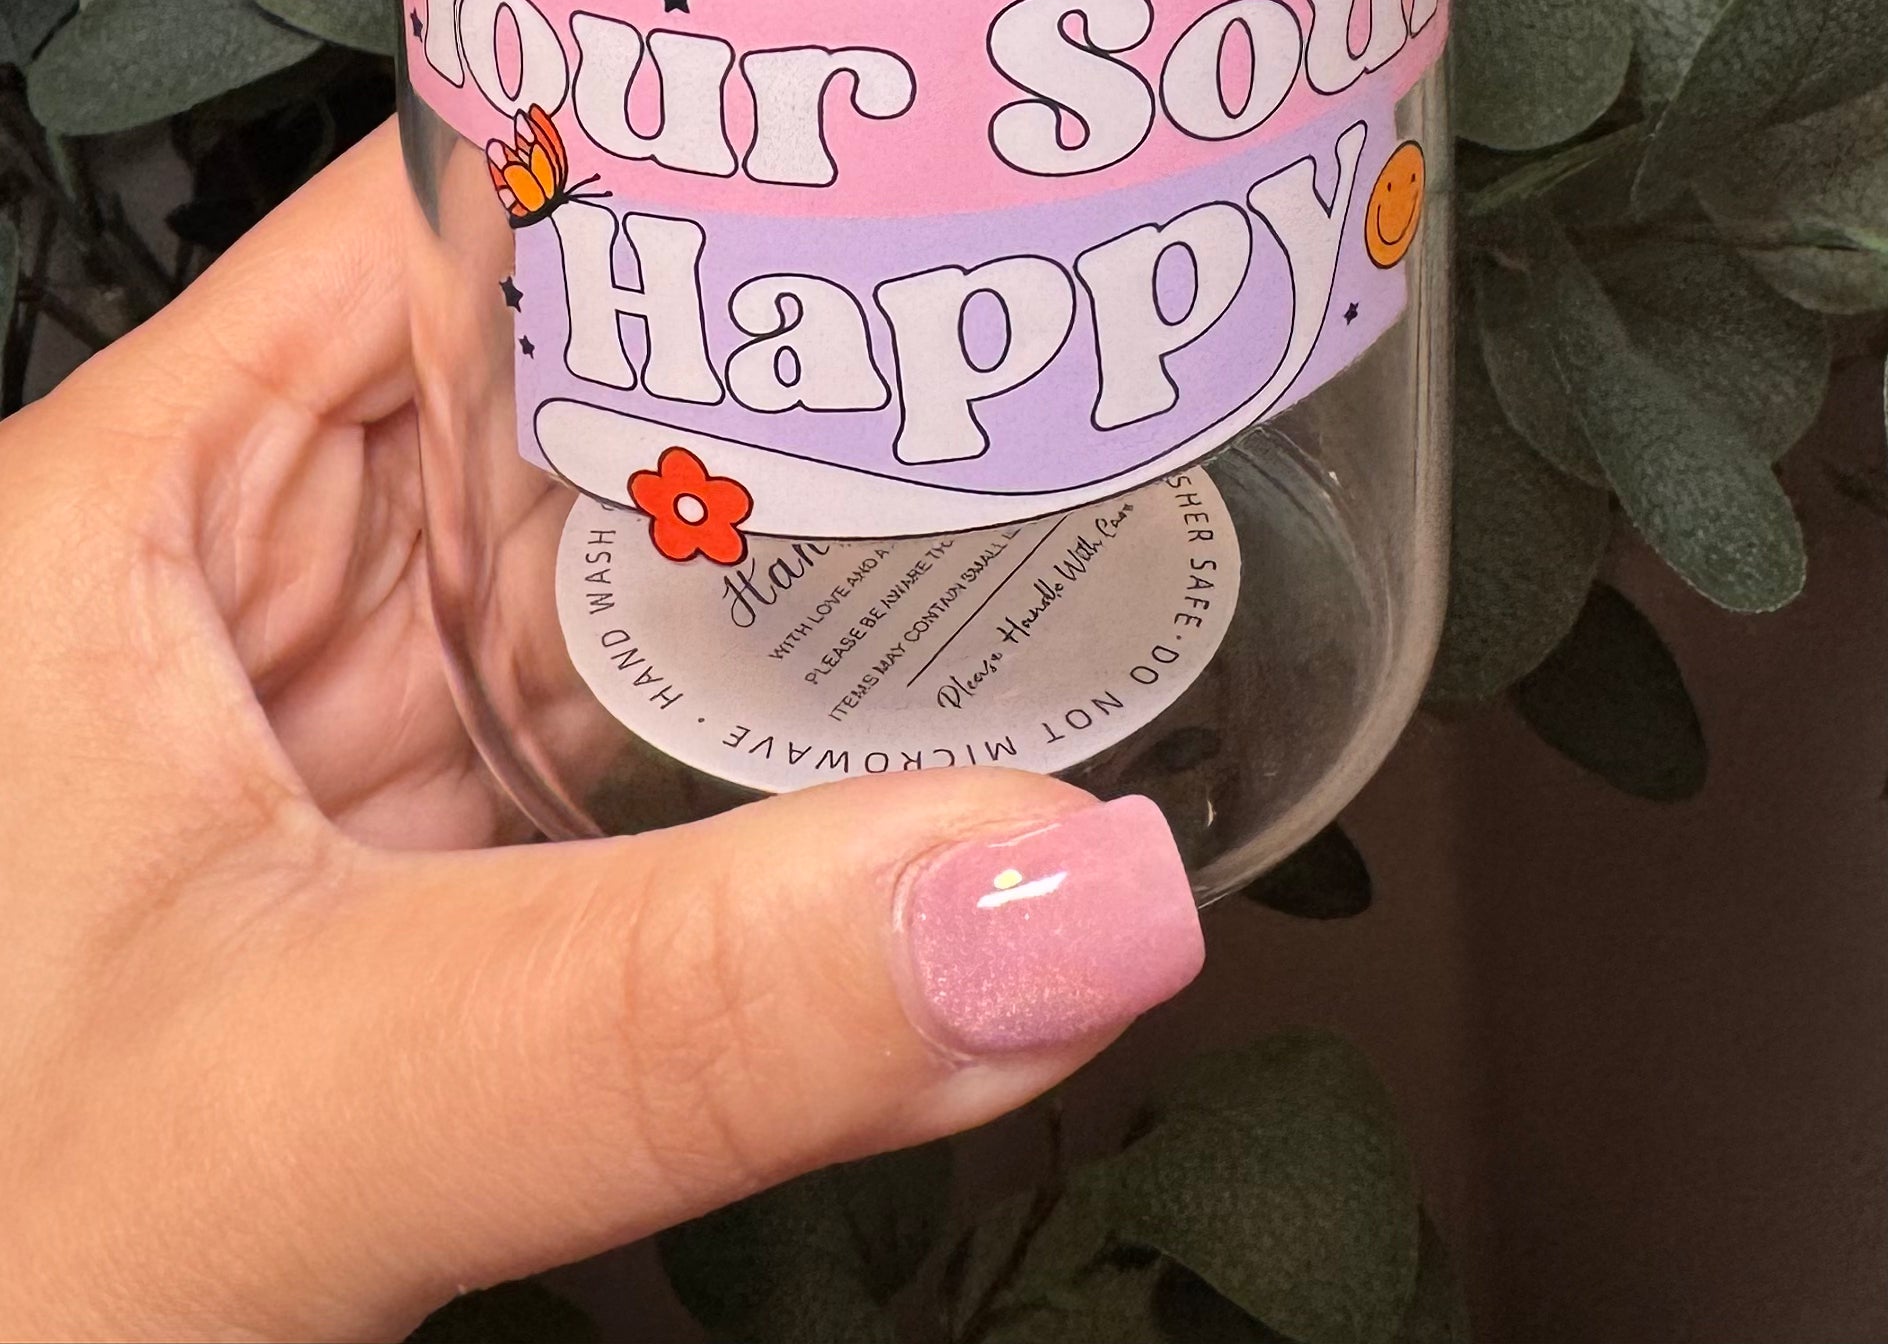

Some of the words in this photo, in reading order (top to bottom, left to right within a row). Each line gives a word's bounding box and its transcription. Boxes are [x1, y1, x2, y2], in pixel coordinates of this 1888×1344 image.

[534, 120, 1368, 537] Happy
[1163, 474, 1214, 542] SHER
[584, 529, 617, 615] WASH
[722, 543, 831, 628] Han
[1174, 557, 1218, 628] SAFE
[769, 623, 813, 660] WITH
[809, 584, 851, 624] LOVE
[804, 626, 868, 685] PLEASE
[859, 607, 887, 629] BE
[937, 651, 1004, 710] Please
[996, 578, 1064, 644] Handle
[1053, 535, 1103, 582] With
[601, 629, 684, 710] HAND
[828, 673, 879, 721] ITEMS
[872, 642, 906, 675] MAY
[1130, 645, 1180, 685] DO
[721, 724, 1018, 774] MICROWAVE
[1041, 690, 1124, 744] NOT
